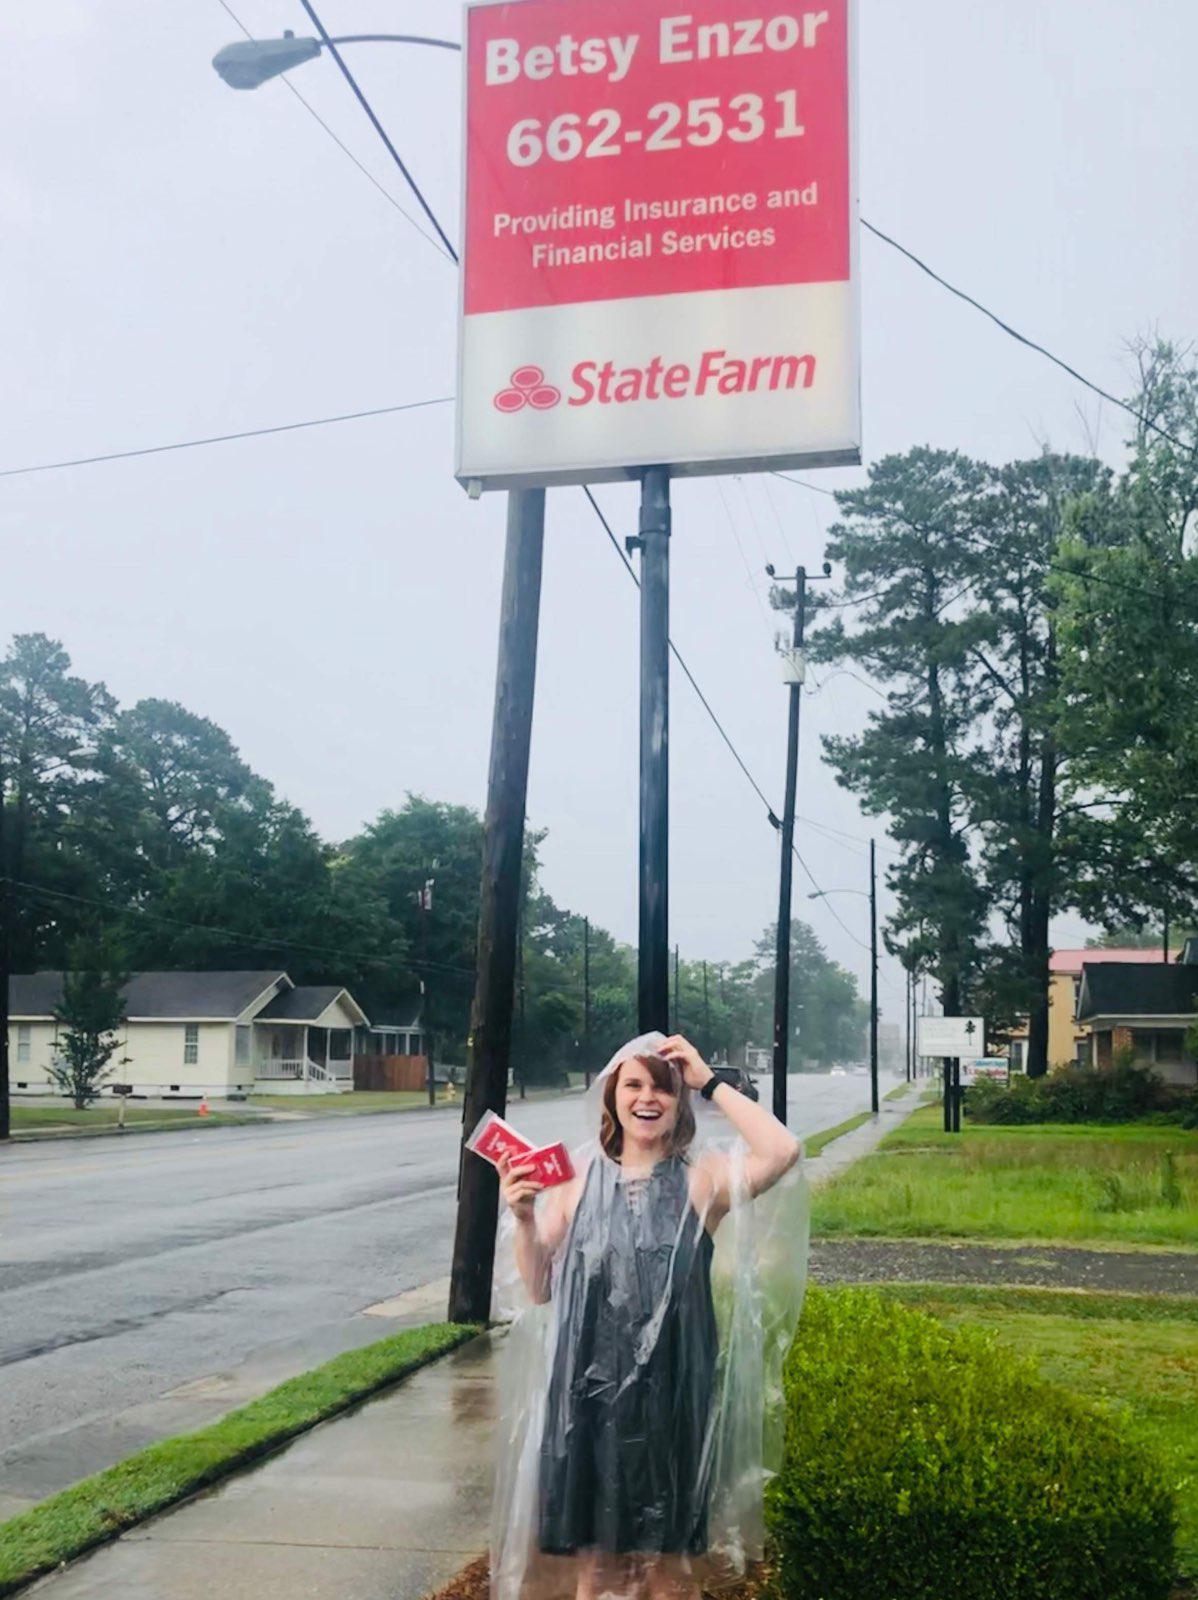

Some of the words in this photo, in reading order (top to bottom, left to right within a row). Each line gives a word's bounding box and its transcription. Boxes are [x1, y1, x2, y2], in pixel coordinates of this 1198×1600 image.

[485, 35, 639, 86] Betsy
[659, 11, 829, 64] Enzor
[506, 89, 805, 167] 662-2531
[493, 204, 615, 237] Providing
[624, 189, 757, 222] Insurance
[767, 182, 817, 207] and
[532, 233, 652, 268] Financial
[662, 226, 776, 256] Services
